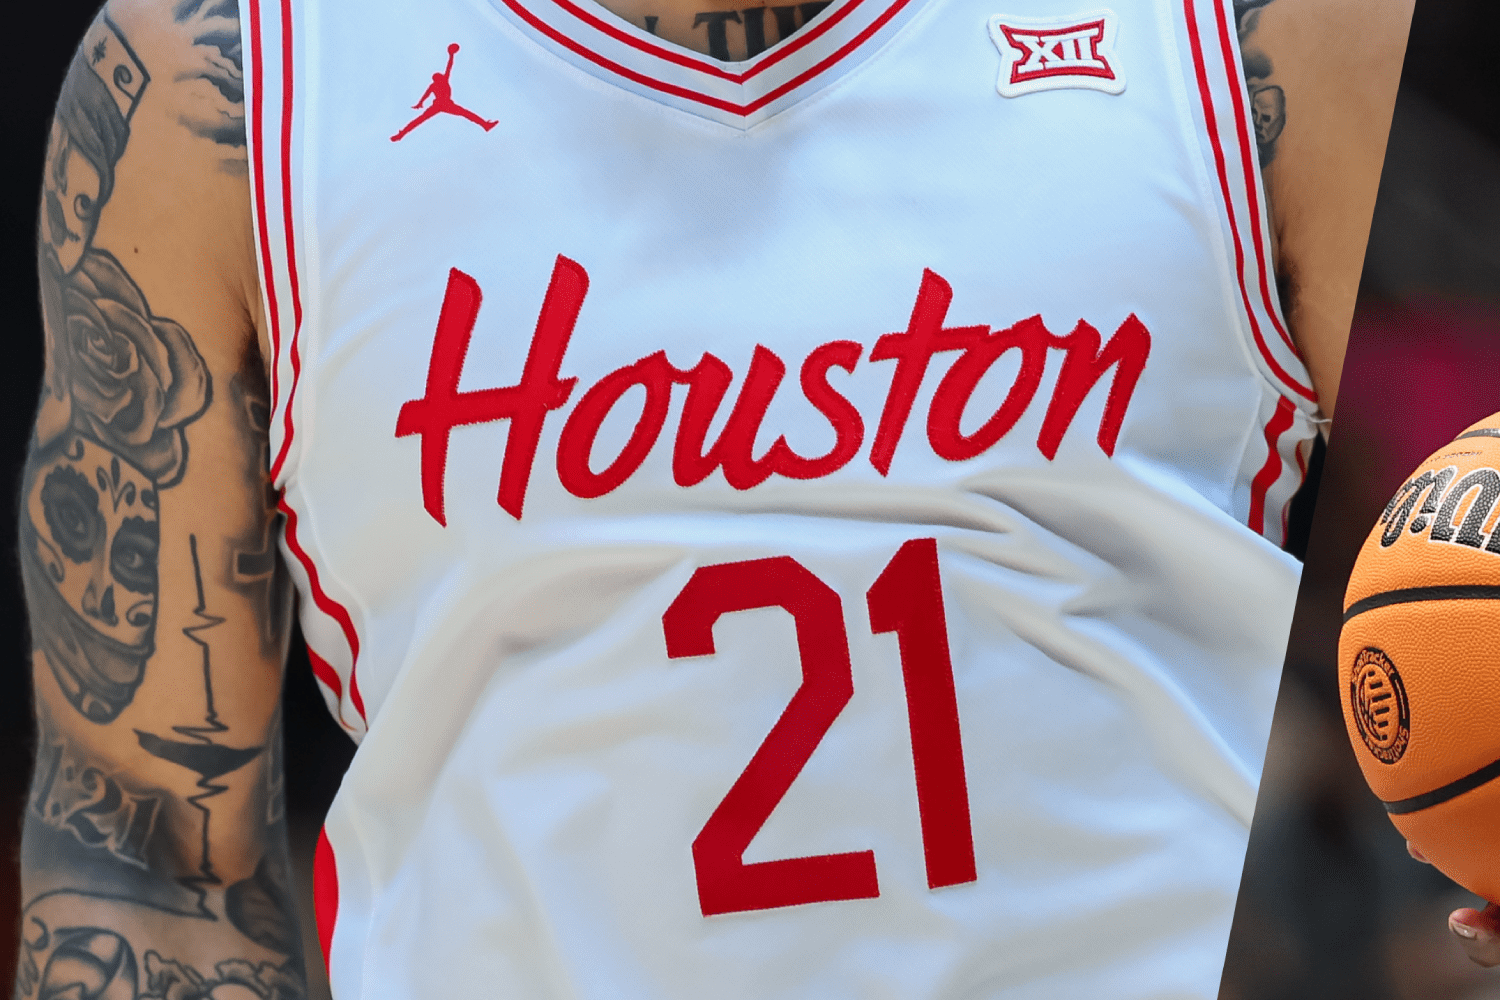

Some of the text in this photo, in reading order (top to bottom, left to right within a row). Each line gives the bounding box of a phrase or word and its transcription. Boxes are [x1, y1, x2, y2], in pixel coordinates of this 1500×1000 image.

[1010, 26, 1106, 75] XII
[395, 254, 1152, 527] Houston
[662, 538, 977, 917] 21
